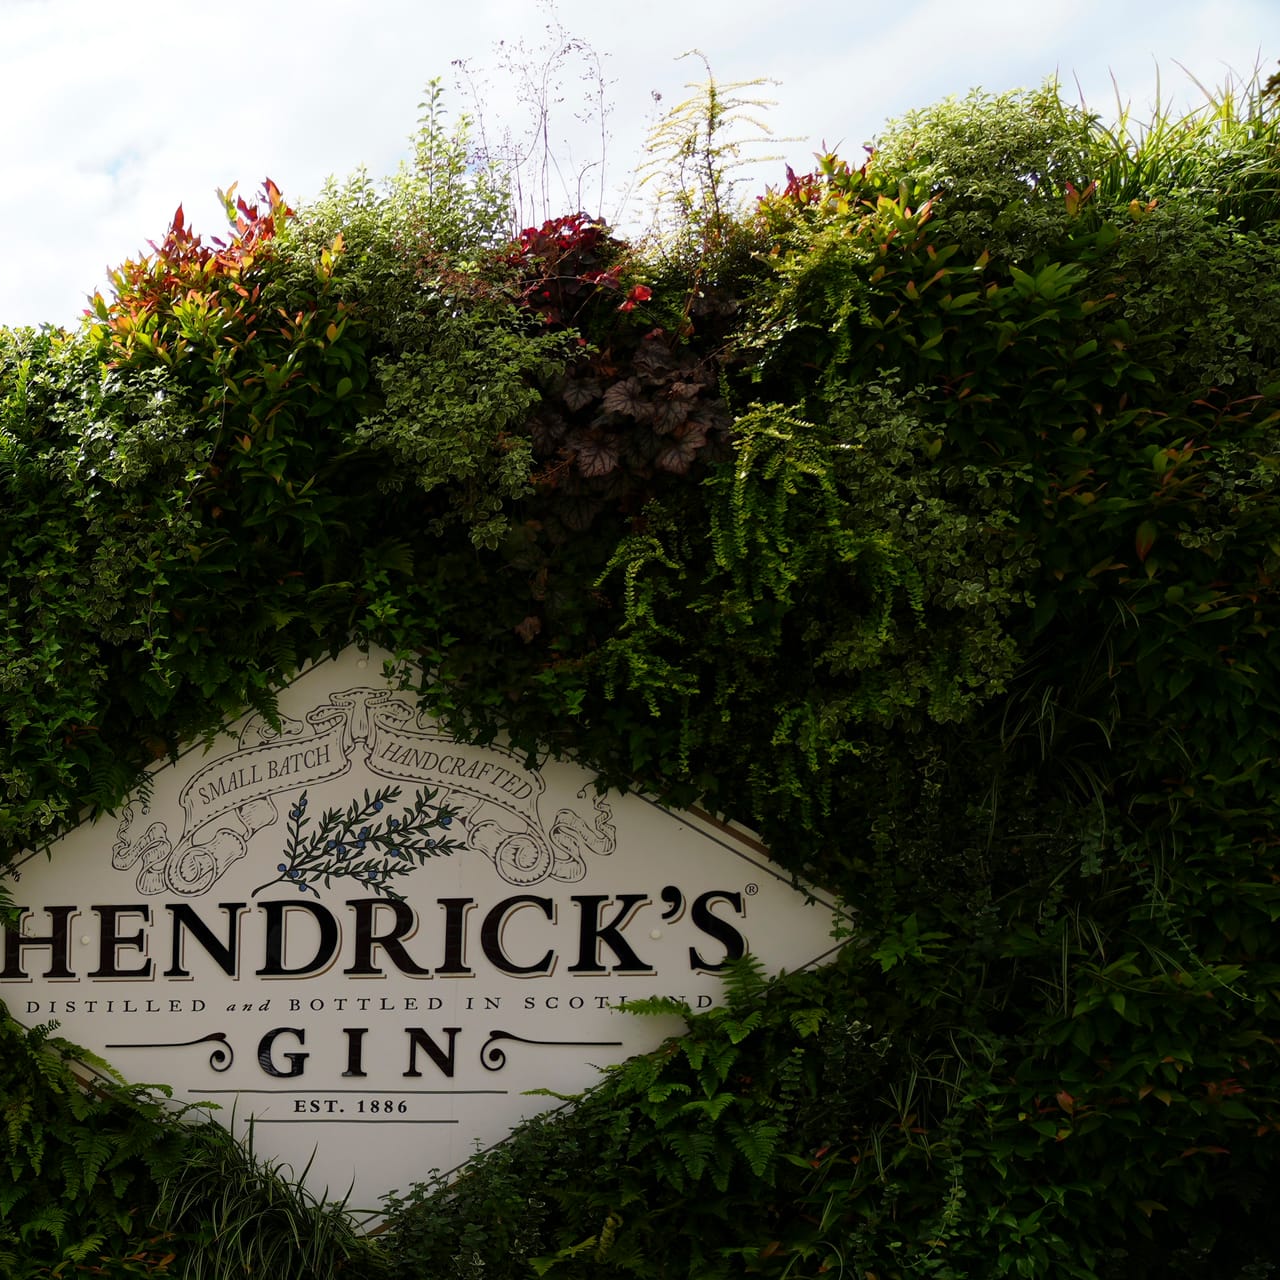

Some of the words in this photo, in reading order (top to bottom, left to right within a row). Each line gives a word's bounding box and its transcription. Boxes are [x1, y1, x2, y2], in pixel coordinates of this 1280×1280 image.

[198, 767, 263, 805] SMALL
[267, 744, 331, 779] BATCH
[380, 740, 535, 801] HANDCRAFTED
[24, 997, 207, 1014] DISTILLED
[225, 996, 273, 1013] and
[289, 995, 445, 1013] BOTTLED
[465, 995, 502, 1011] IN
[257, 1027, 463, 1079] GIN
[293, 1098, 347, 1115] EST.
[357, 1098, 408, 1115] 1886
